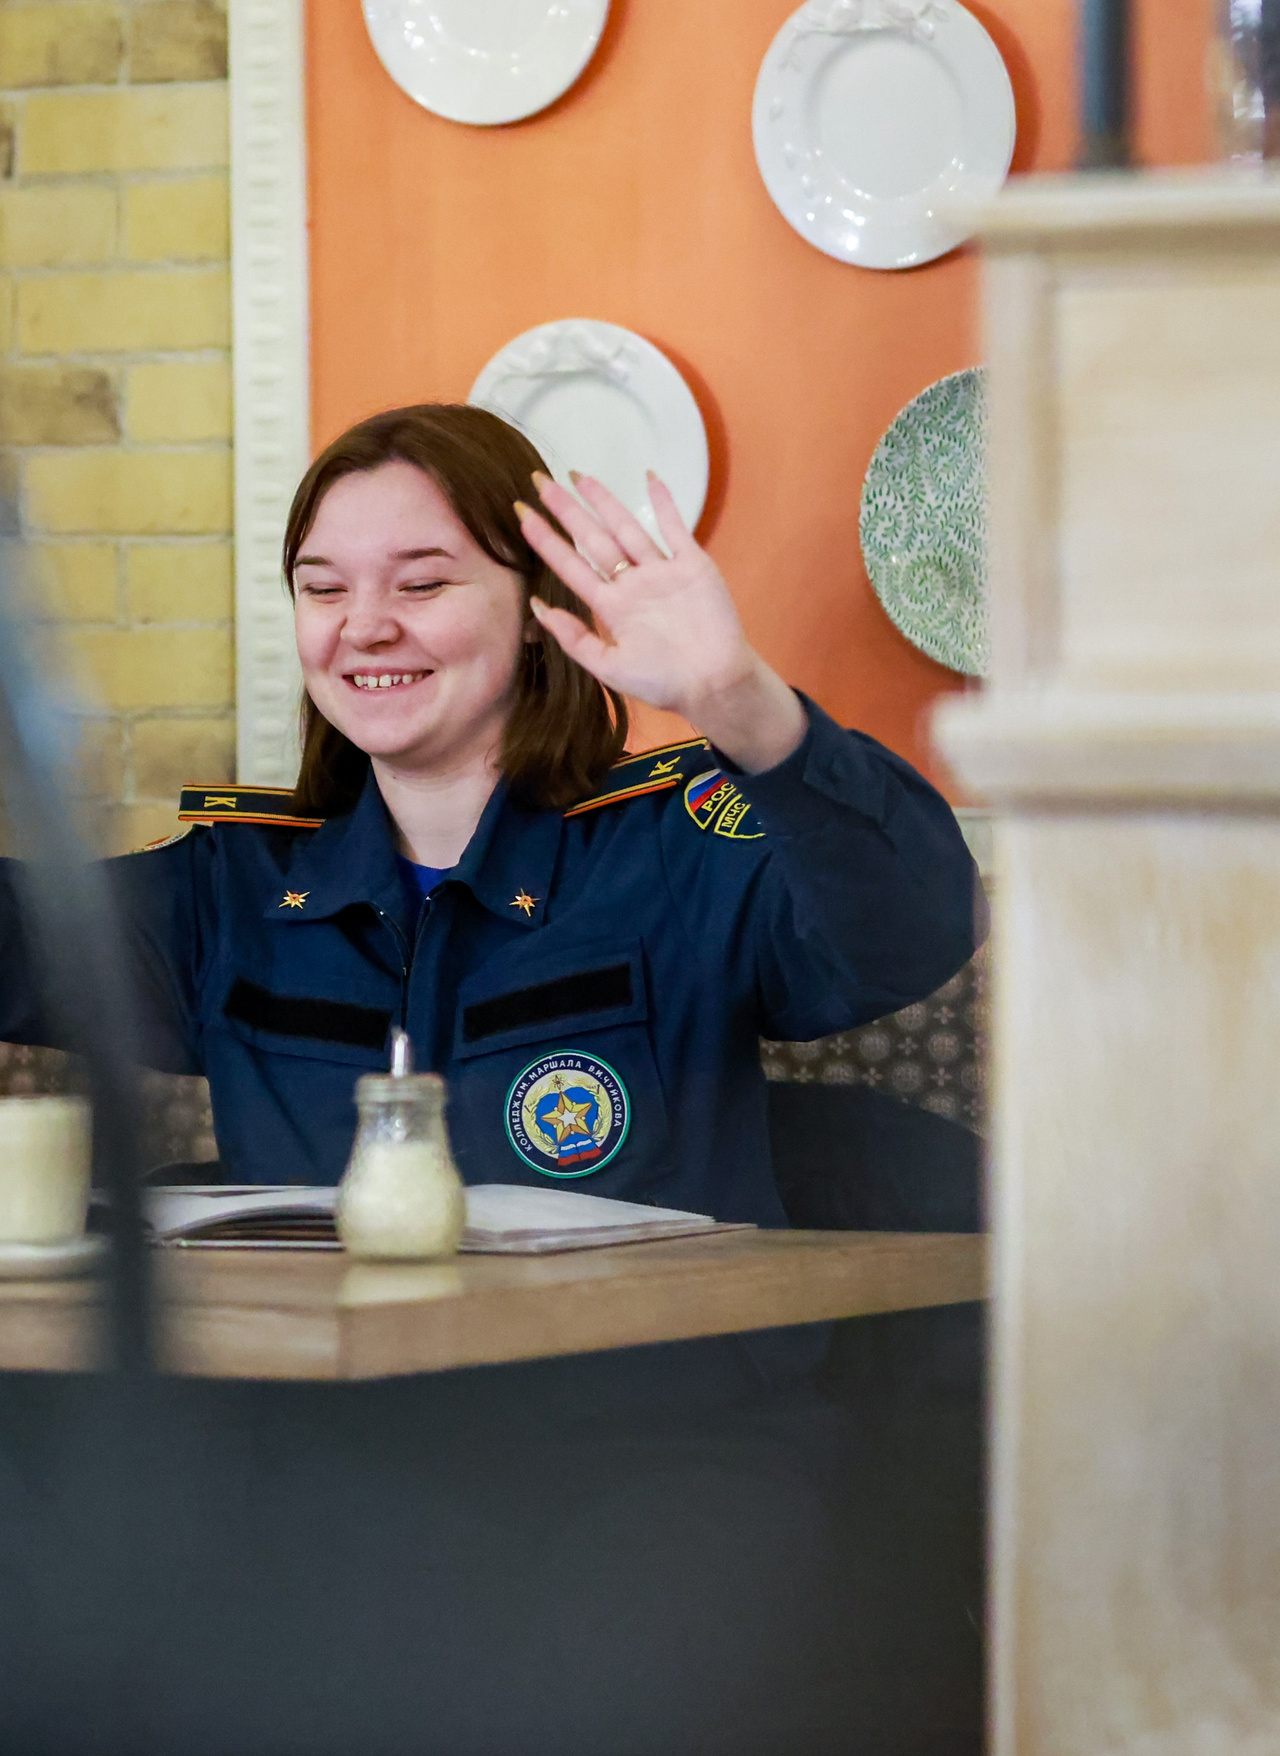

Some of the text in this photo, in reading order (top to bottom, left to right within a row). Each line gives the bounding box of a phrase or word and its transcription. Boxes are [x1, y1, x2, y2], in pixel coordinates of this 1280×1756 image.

[701, 782, 735, 812] РОС
[721, 802, 746, 828] МЧС
[528, 1060, 582, 1081] МАРШАЛА
[516, 1082, 531, 1098] ИМ.
[512, 1100, 533, 1152] КОЛЛЕДЖ
